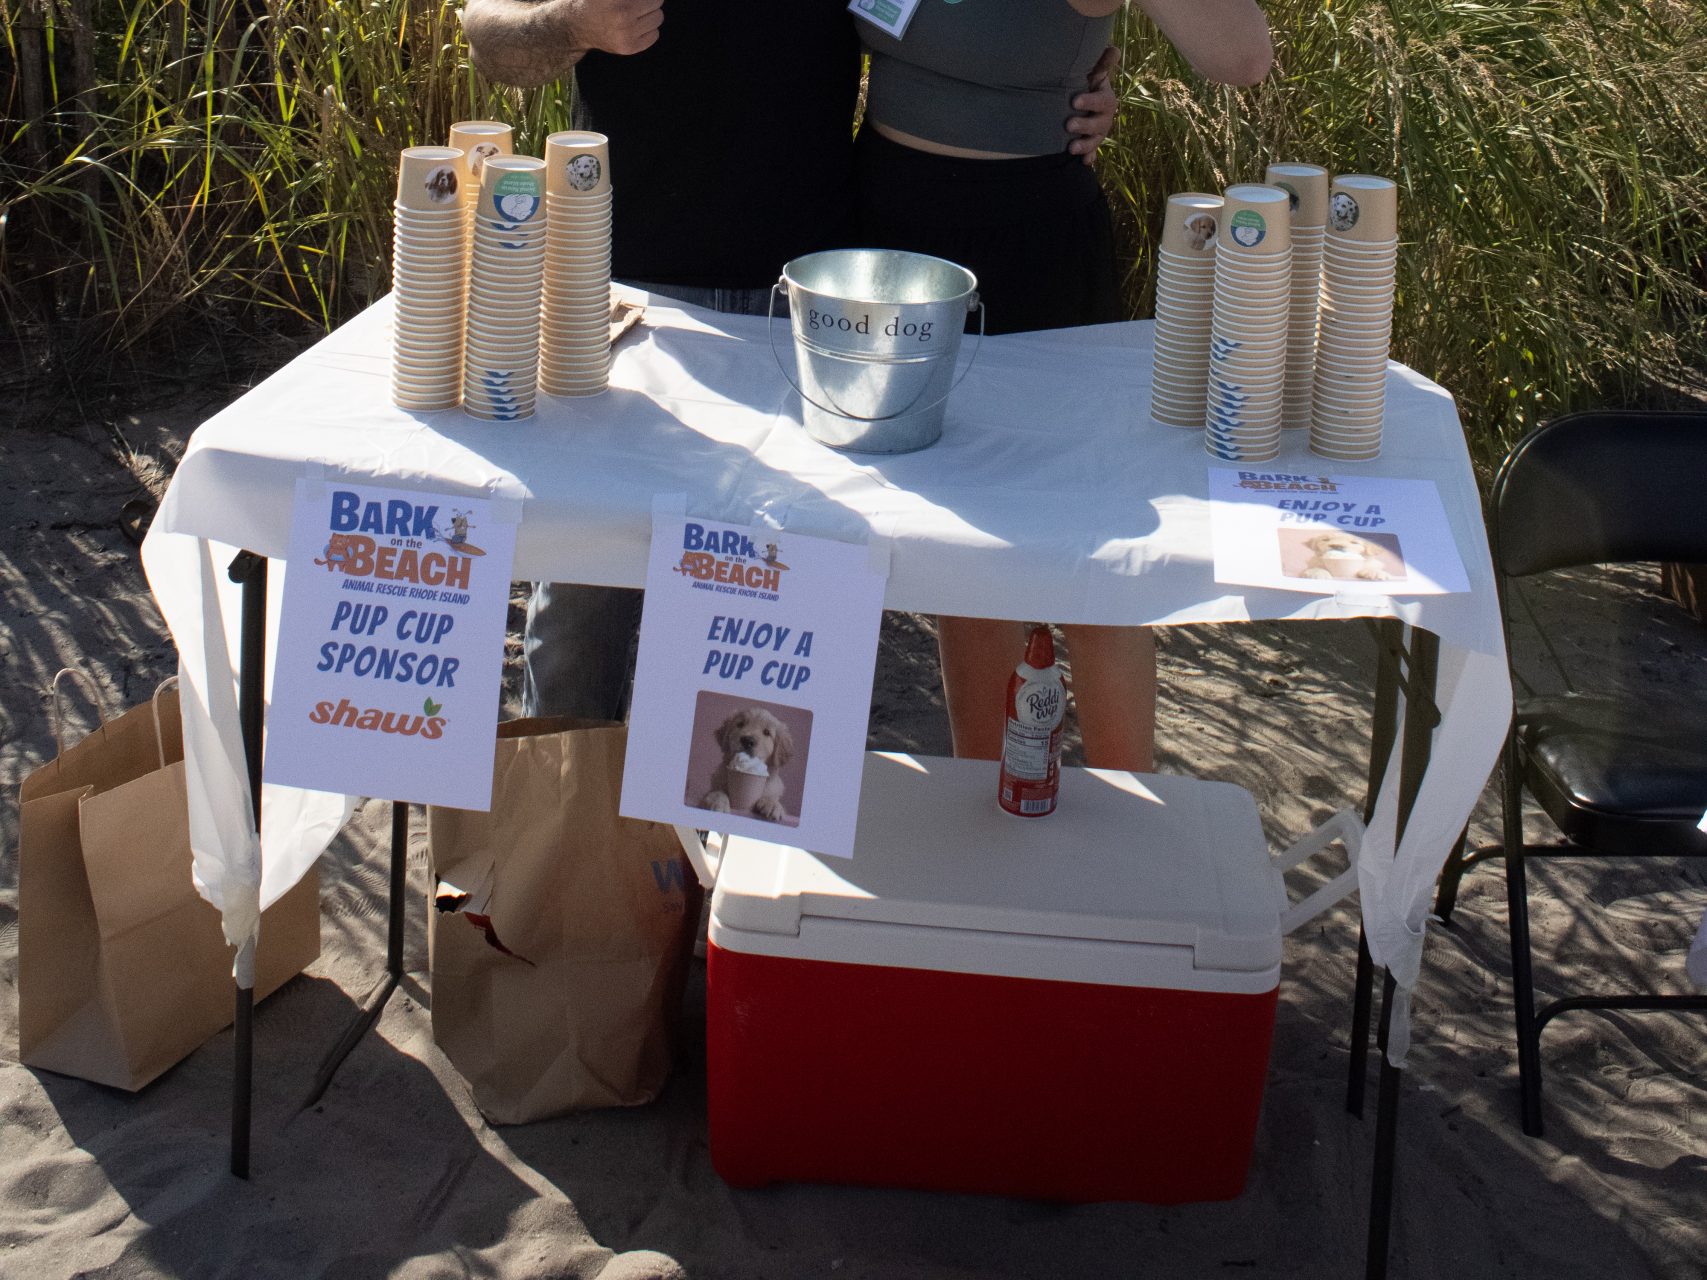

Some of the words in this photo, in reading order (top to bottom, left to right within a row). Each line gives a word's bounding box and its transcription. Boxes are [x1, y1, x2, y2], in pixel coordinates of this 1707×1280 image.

[809, 309, 870, 334] good
[885, 317, 934, 342] dog
[330, 491, 440, 539] BARK
[1278, 499, 1357, 513] ENJOY
[1365, 504, 1382, 515] A
[1280, 512, 1328, 524] PUP
[1337, 515, 1386, 527] CUP
[390, 538, 404, 546] on
[406, 538, 423, 549] the
[684, 522, 757, 558] BARK
[343, 534, 472, 590] BEACH
[692, 552, 780, 592] BEACH
[736, 556, 747, 565] the
[342, 578, 375, 592] ANIMAL
[376, 584, 408, 598] RESCUE
[409, 589, 439, 601] RHODE
[440, 592, 470, 605] ISLAND
[692, 581, 714, 591] ANIMAL
[715, 585, 737, 594] RESCUE
[738, 588, 759, 598] RHODE
[758, 592, 780, 602] ISLAND
[330, 600, 388, 636] PUP
[396, 610, 454, 644] CUP
[707, 616, 790, 650] ENJOY
[794, 631, 814, 658] A
[317, 641, 460, 688] SPONSOR
[702, 650, 754, 680] PUP
[760, 660, 811, 691] CUP
[1026, 688, 1060, 714] Reddi
[1036, 704, 1058, 720] wip
